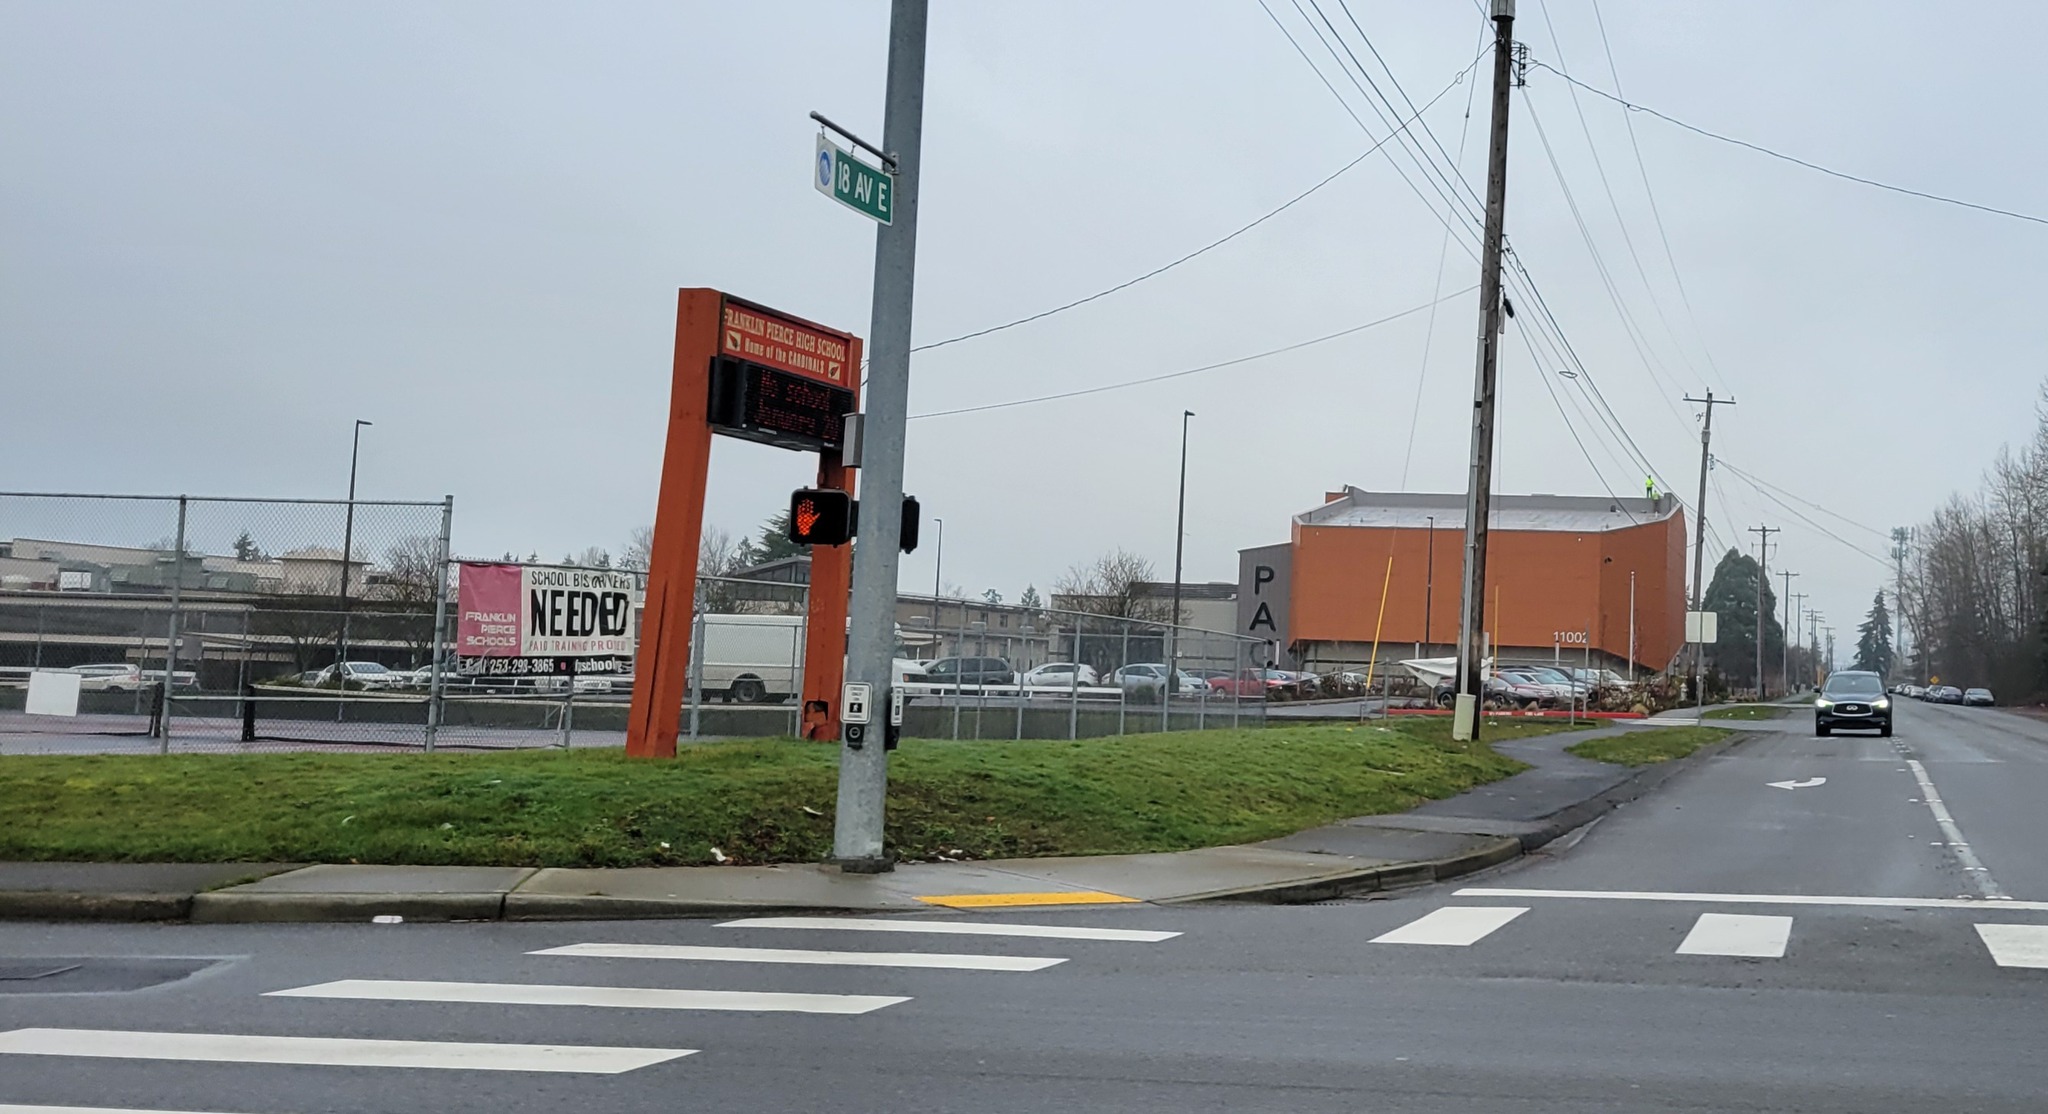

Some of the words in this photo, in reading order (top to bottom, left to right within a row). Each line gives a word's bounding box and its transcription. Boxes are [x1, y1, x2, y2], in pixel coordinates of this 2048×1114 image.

[838, 161, 851, 194] 18
[854, 172, 873, 205] AV
[878, 181, 888, 213] E
[724, 308, 765, 337] FRANKLIN
[766, 321, 794, 346] PIERCE
[796, 330, 816, 353] HIGH
[817, 338, 845, 362] SCHOOL
[766, 345, 775, 360] of
[776, 347, 786, 364] the
[788, 350, 825, 375] CARDINALS
[531, 571, 570, 587] SCHOOL
[465, 611, 516, 623] FRANKLIN
[530, 589, 629, 637] NEEDED
[481, 624, 516, 635] PIERCE
[1553, 631, 1587, 644] 11002
[466, 636, 516, 647] SCHOOLS
